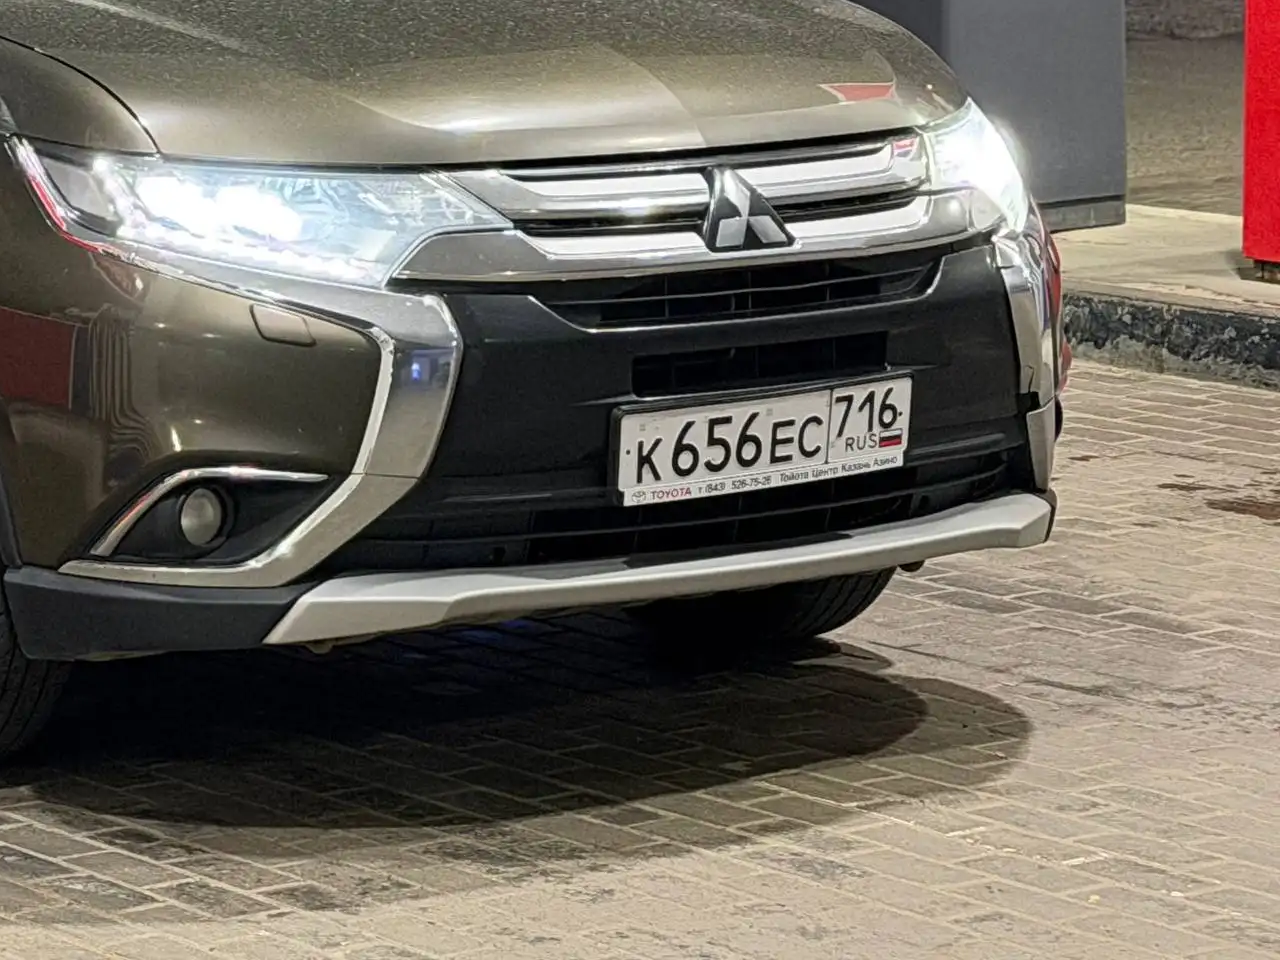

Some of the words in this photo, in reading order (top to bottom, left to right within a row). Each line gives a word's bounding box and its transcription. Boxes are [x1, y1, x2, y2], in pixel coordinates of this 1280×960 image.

[835, 387, 899, 439] 716
[845, 433, 877, 452] RUS
[651, 487, 692, 500] TOYOTA
[811, 466, 838, 479] Центр
